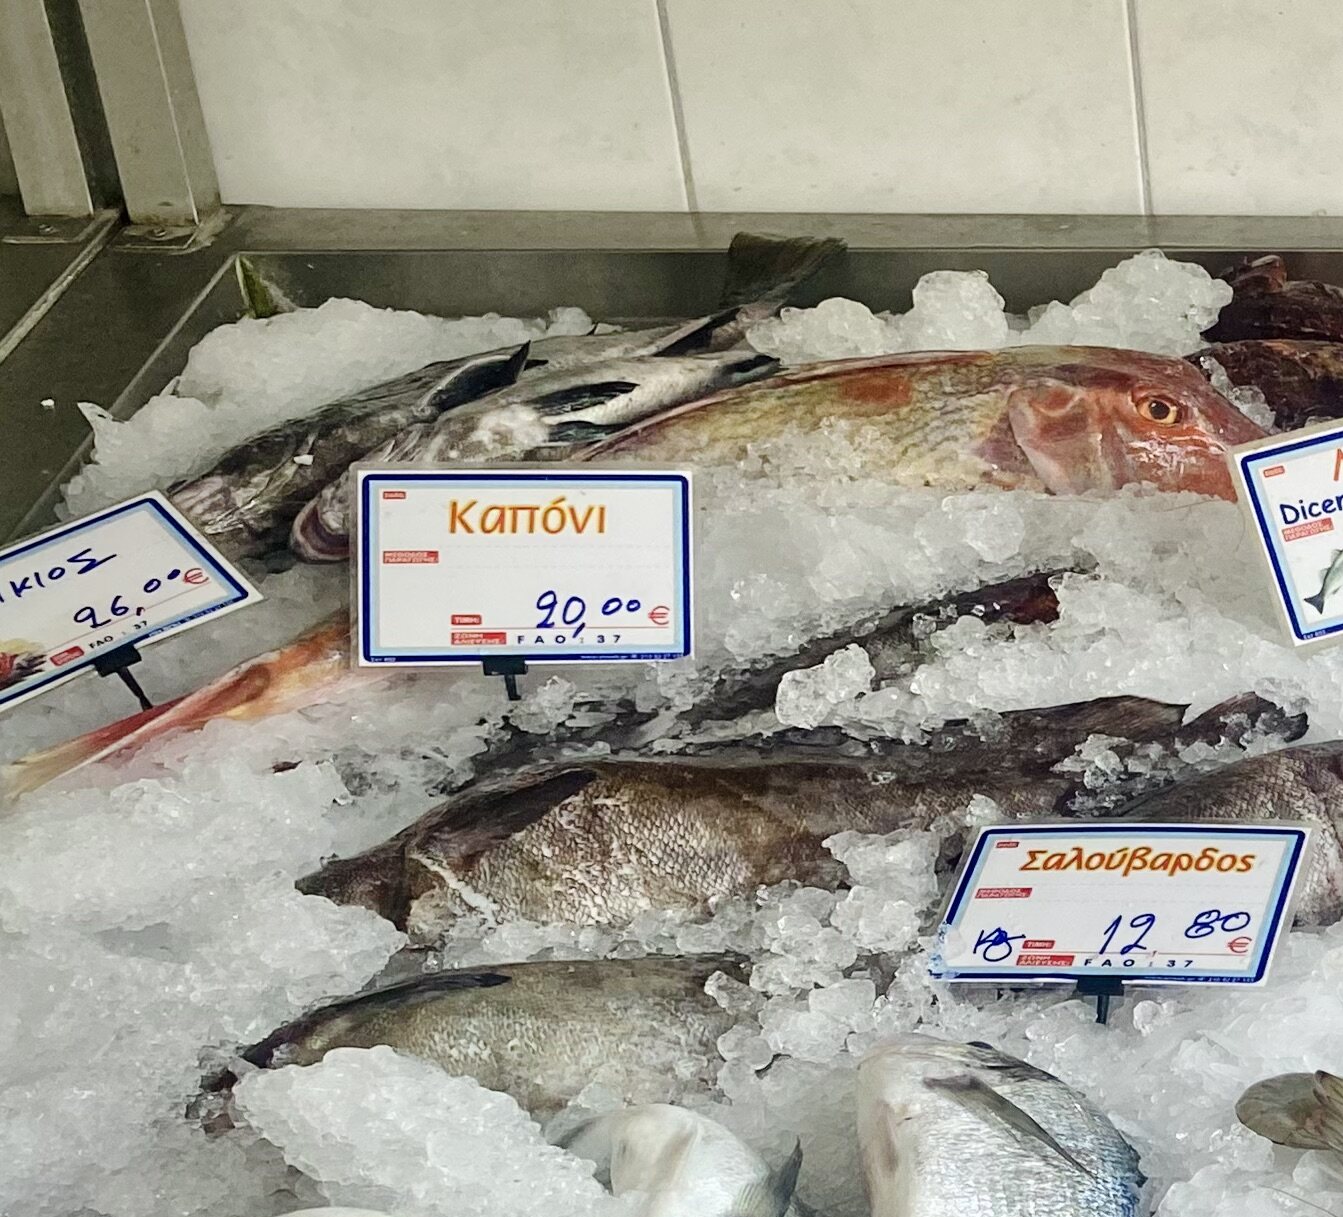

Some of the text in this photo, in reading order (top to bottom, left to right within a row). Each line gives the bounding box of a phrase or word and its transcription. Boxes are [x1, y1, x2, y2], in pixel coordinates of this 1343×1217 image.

[448, 496, 606, 534] Καπόνι
[0, 548, 118, 603] ΚΙΟΣ
[1018, 845, 1257, 877] Σαλούβαρδος
